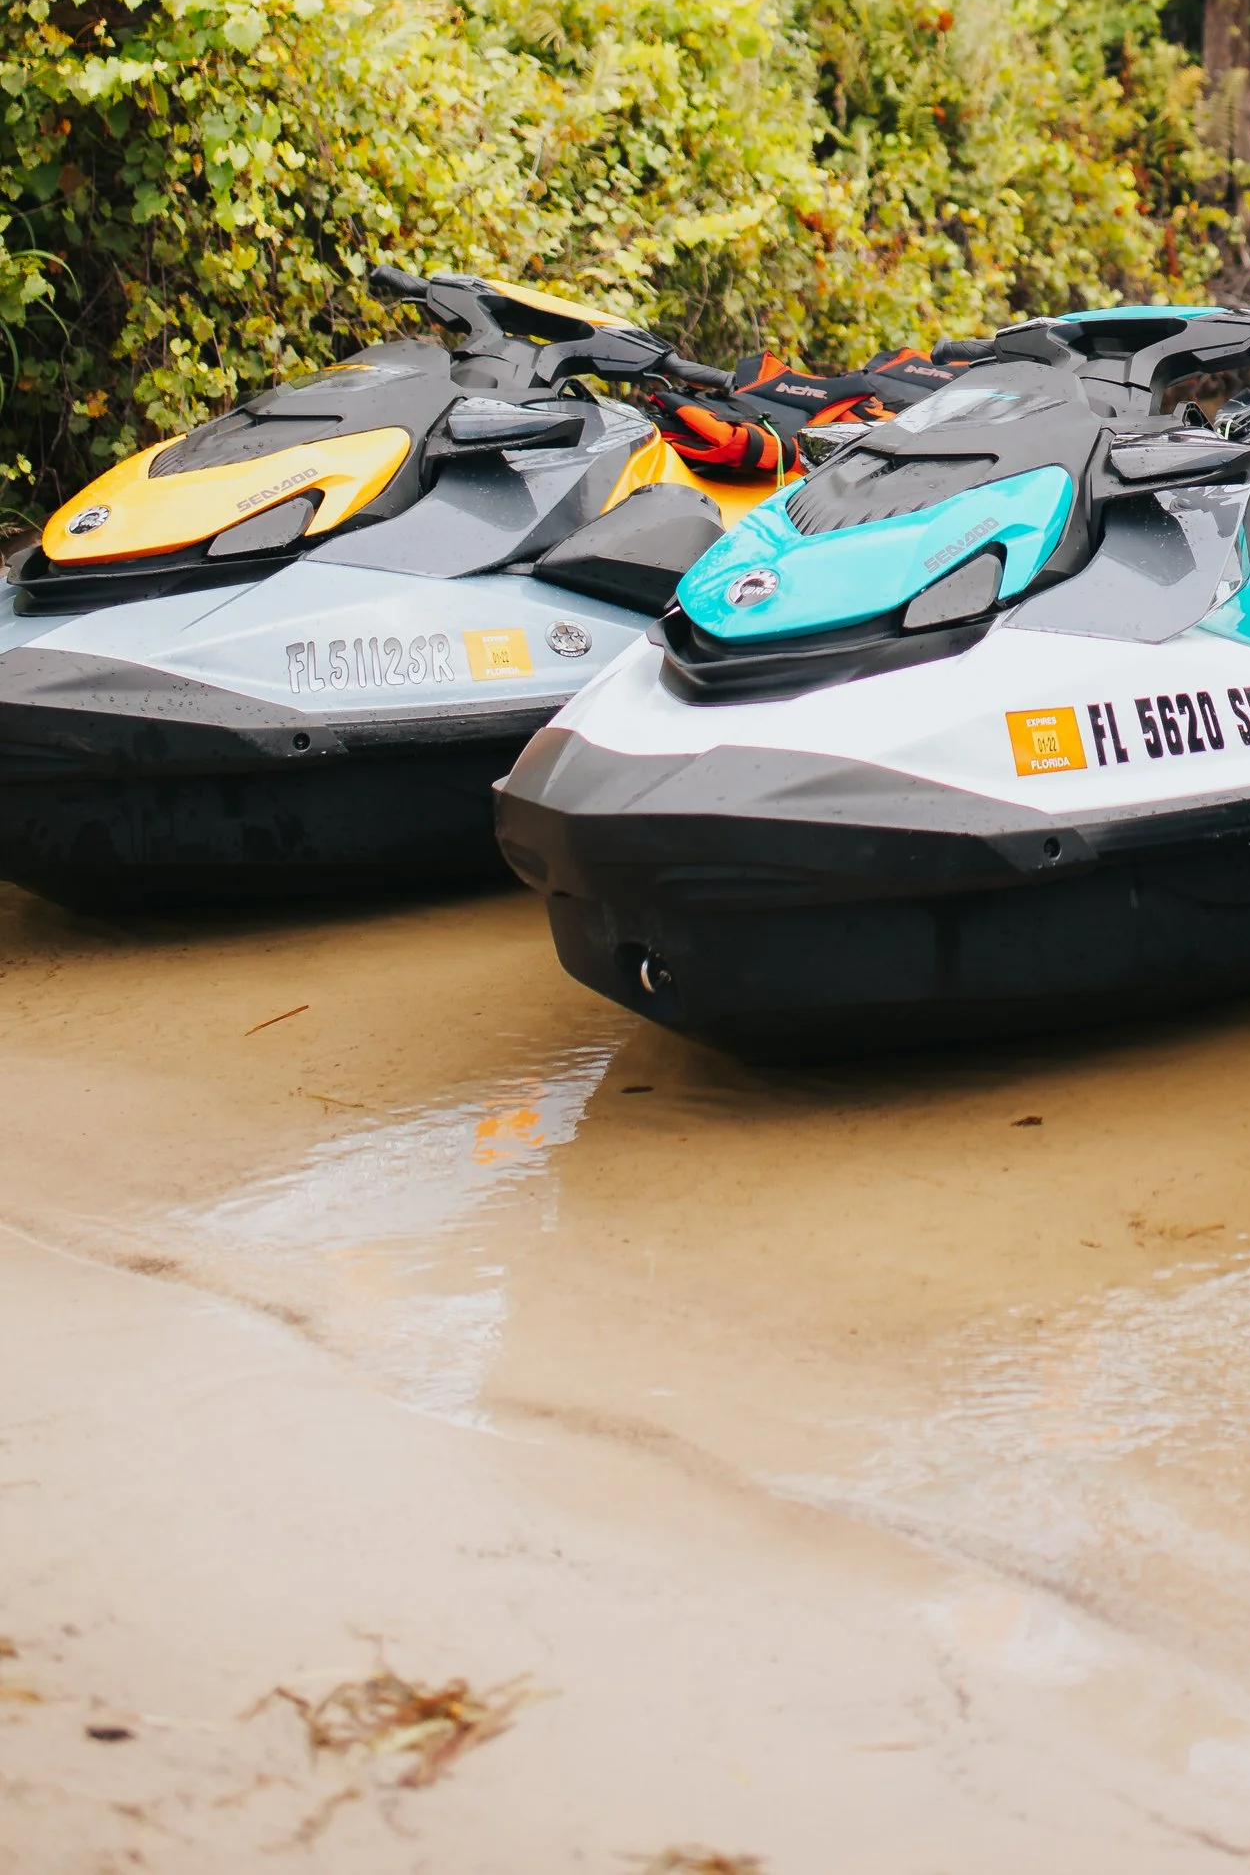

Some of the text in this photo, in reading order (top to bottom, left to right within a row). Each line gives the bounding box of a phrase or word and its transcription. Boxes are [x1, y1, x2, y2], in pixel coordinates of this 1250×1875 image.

[286, 633, 455, 693] FL5112SR
[1026, 716, 1057, 727] EXPIRES
[1087, 702, 1130, 767] FL
[1134, 691, 1225, 759] 5620
[1038, 737, 1057, 752] 01-22
[1031, 757, 1070, 770] FLORIDA
